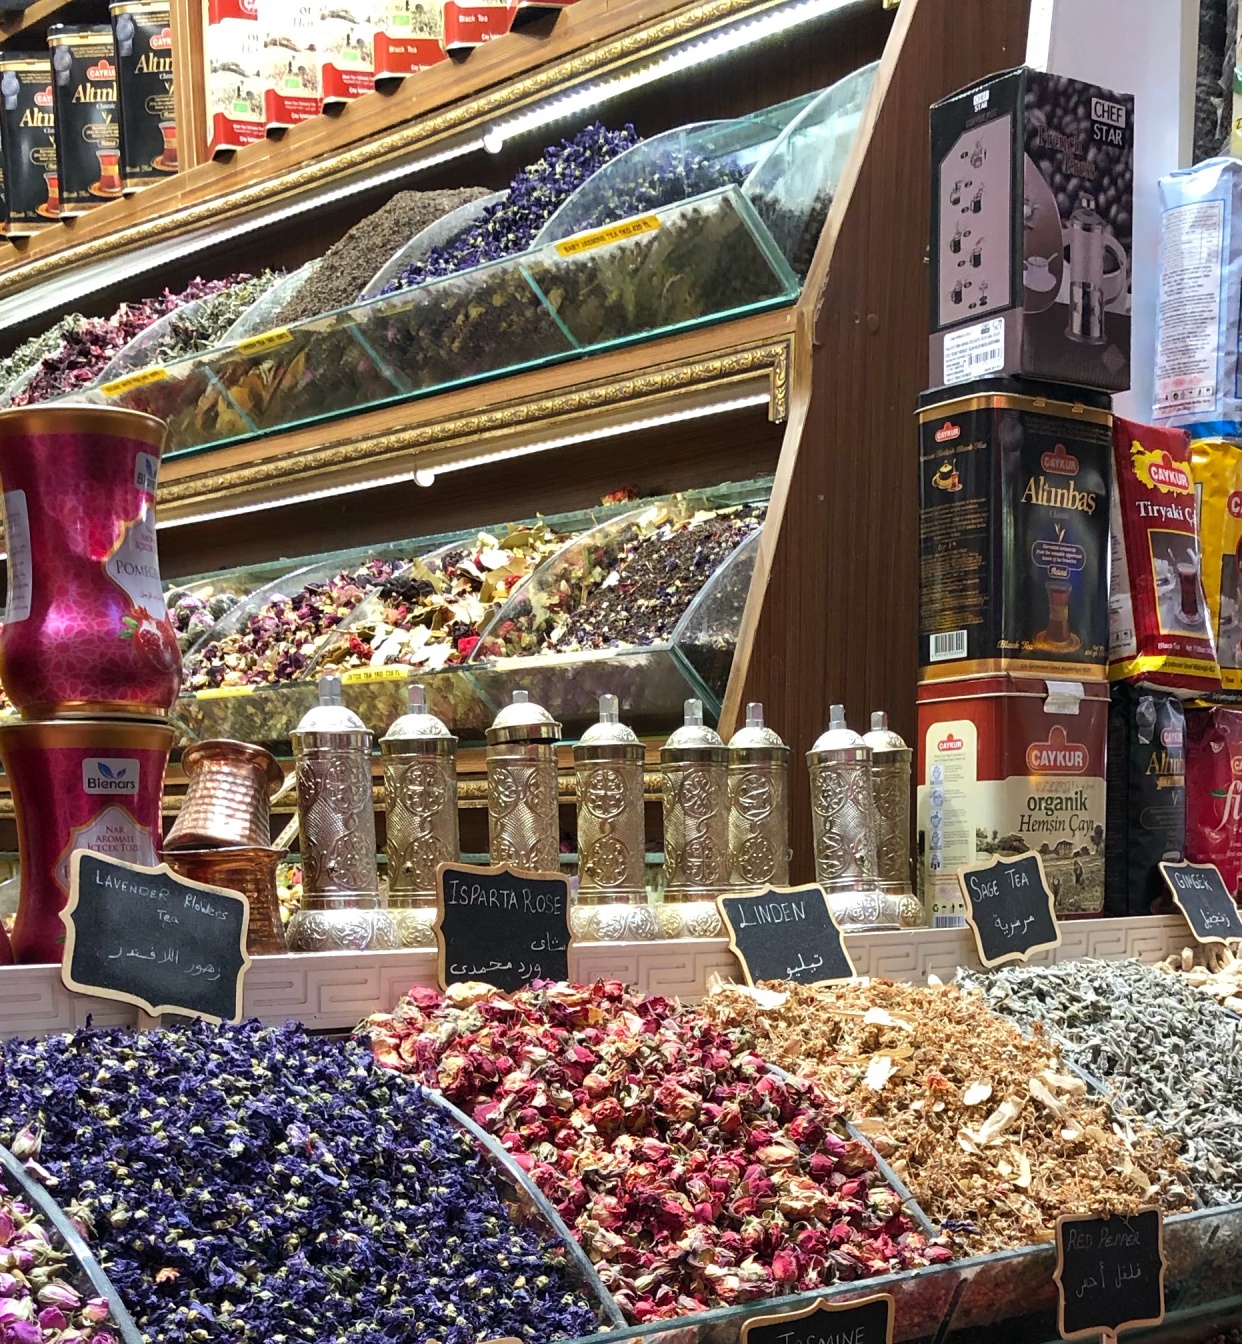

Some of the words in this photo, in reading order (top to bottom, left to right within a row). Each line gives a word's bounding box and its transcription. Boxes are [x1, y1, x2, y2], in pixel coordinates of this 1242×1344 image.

[458, 15, 475, 23] Black
[477, 14, 488, 22] Tea
[388, 45, 405, 53] Black
[1094, 101, 1123, 123] CHEF
[1093, 123, 1123, 146] STAR
[563, 243, 579, 253] BABY
[606, 231, 618, 240] TEA
[1020, 475, 1096, 516] Altınbaş
[1135, 500, 1184, 522] Tiryaki
[87, 777, 136, 789] Bienars
[1027, 790, 1088, 816] organik
[105, 825, 125, 834] NAR
[1018, 814, 1066, 835] Hemşin
[95, 869, 170, 901] LAVENDER
[970, 875, 1000, 902] SAGE
[1004, 868, 1029, 889] TEA
[1174, 872, 1213, 892] GINGER
[448, 879, 519, 909] ISPARTA
[522, 888, 562, 915] ROSE
[157, 909, 179, 925] Tea
[738, 901, 806, 928] LINDEN
[1067, 1228, 1093, 1252] RED
[1098, 1227, 1141, 1249] PEPPER
